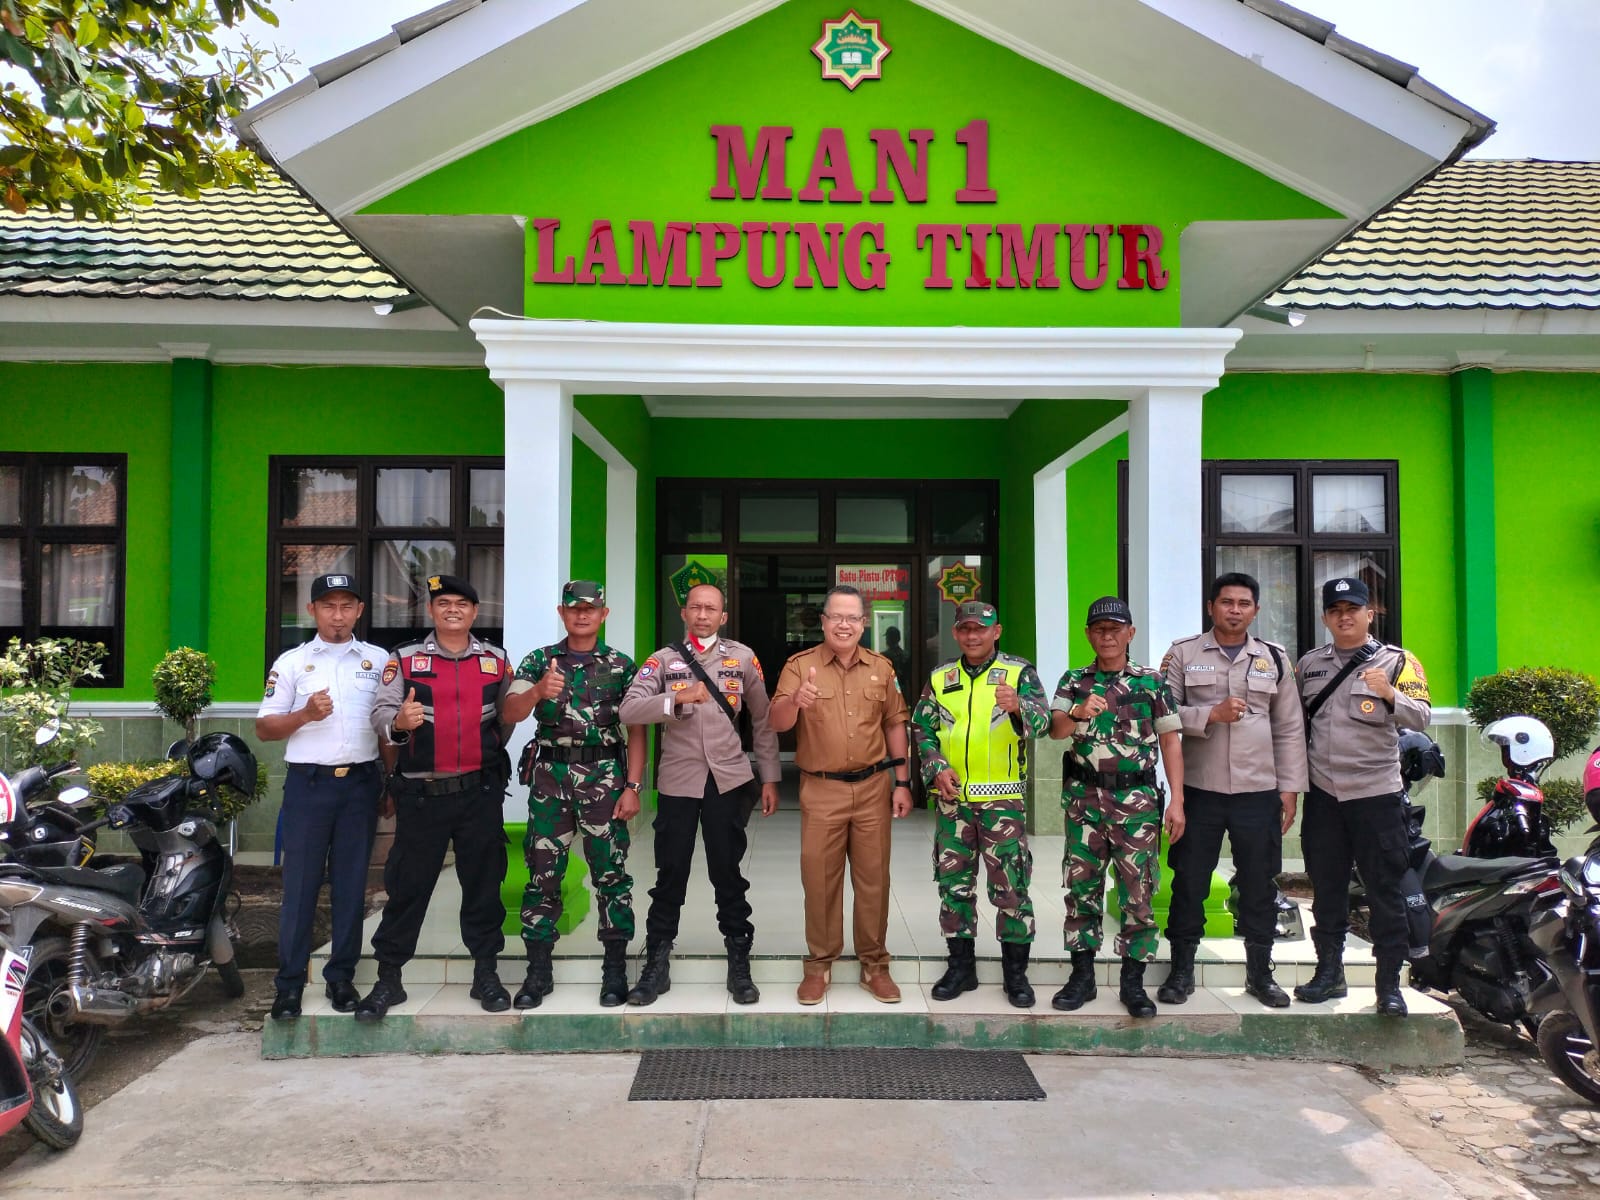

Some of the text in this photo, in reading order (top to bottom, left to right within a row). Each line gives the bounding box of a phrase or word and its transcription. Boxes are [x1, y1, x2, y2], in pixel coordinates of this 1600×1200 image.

[710, 119, 998, 204] MAN 1
[532, 218, 1170, 291] LAMPUNG TIMUR
[839, 569, 856, 582] Satu
[859, 569, 880, 582] Pintu
